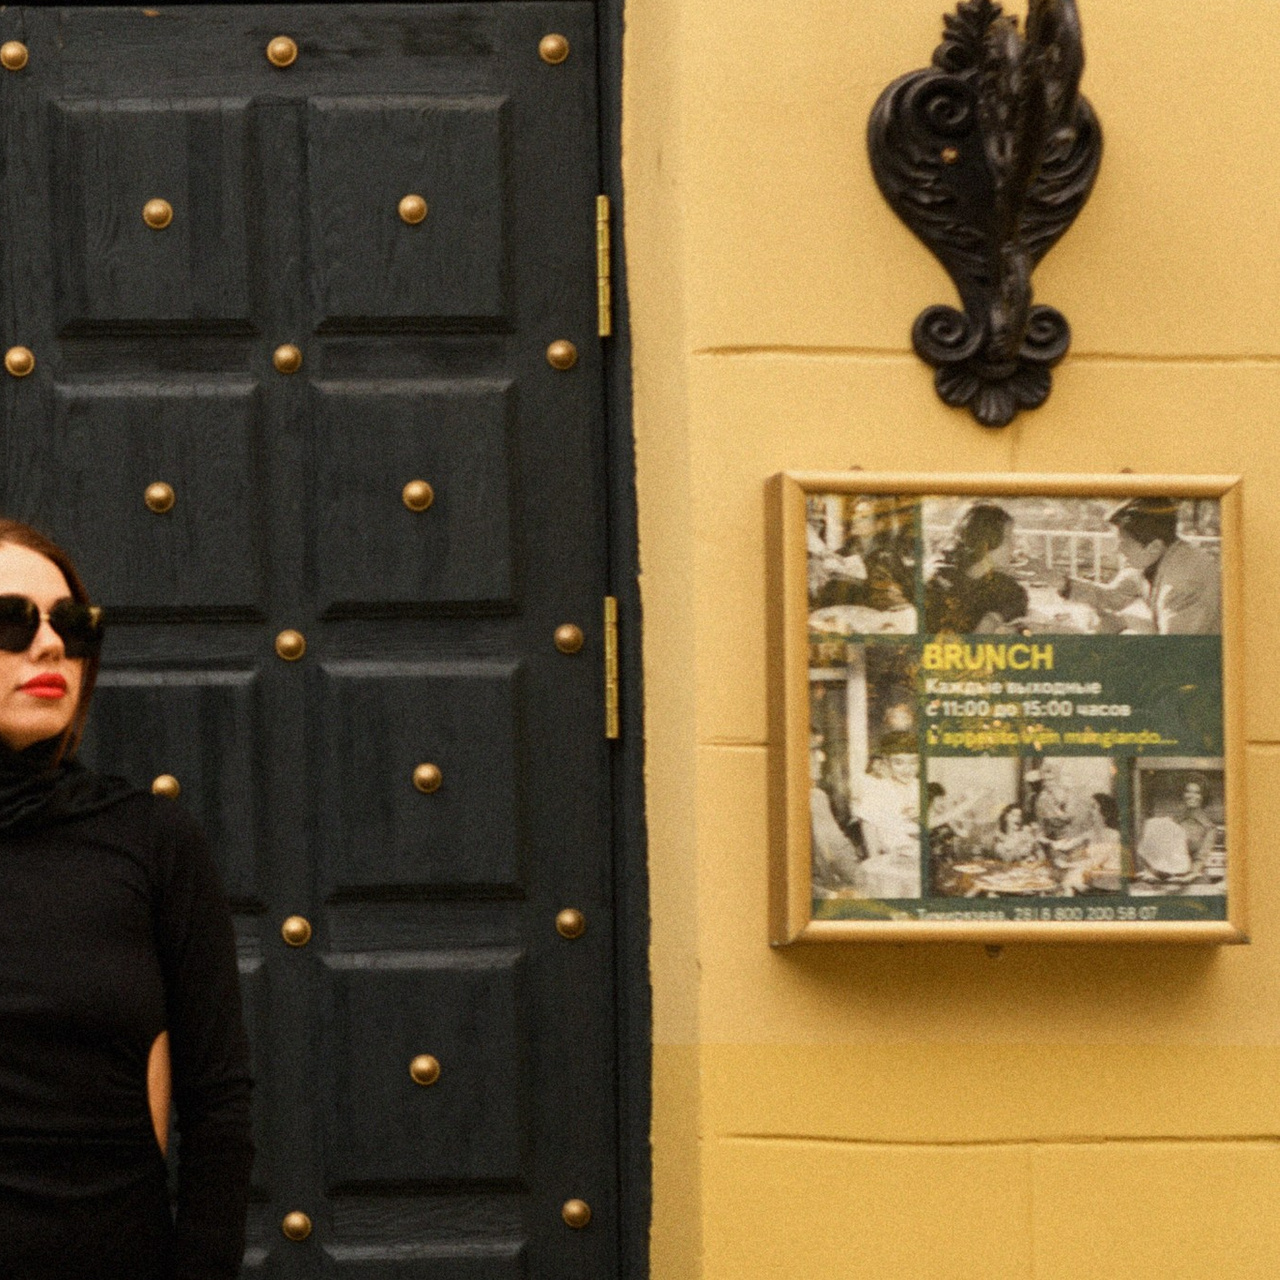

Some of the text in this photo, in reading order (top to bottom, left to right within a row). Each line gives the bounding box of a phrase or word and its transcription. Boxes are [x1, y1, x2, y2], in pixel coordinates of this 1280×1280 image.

[923, 643, 1054, 670] BRUNCH
[925, 678, 1102, 696] Каждые выходные
[942, 700, 990, 717] 11:00
[1022, 700, 1073, 717] 15:00
[1075, 704, 1132, 717] часов
